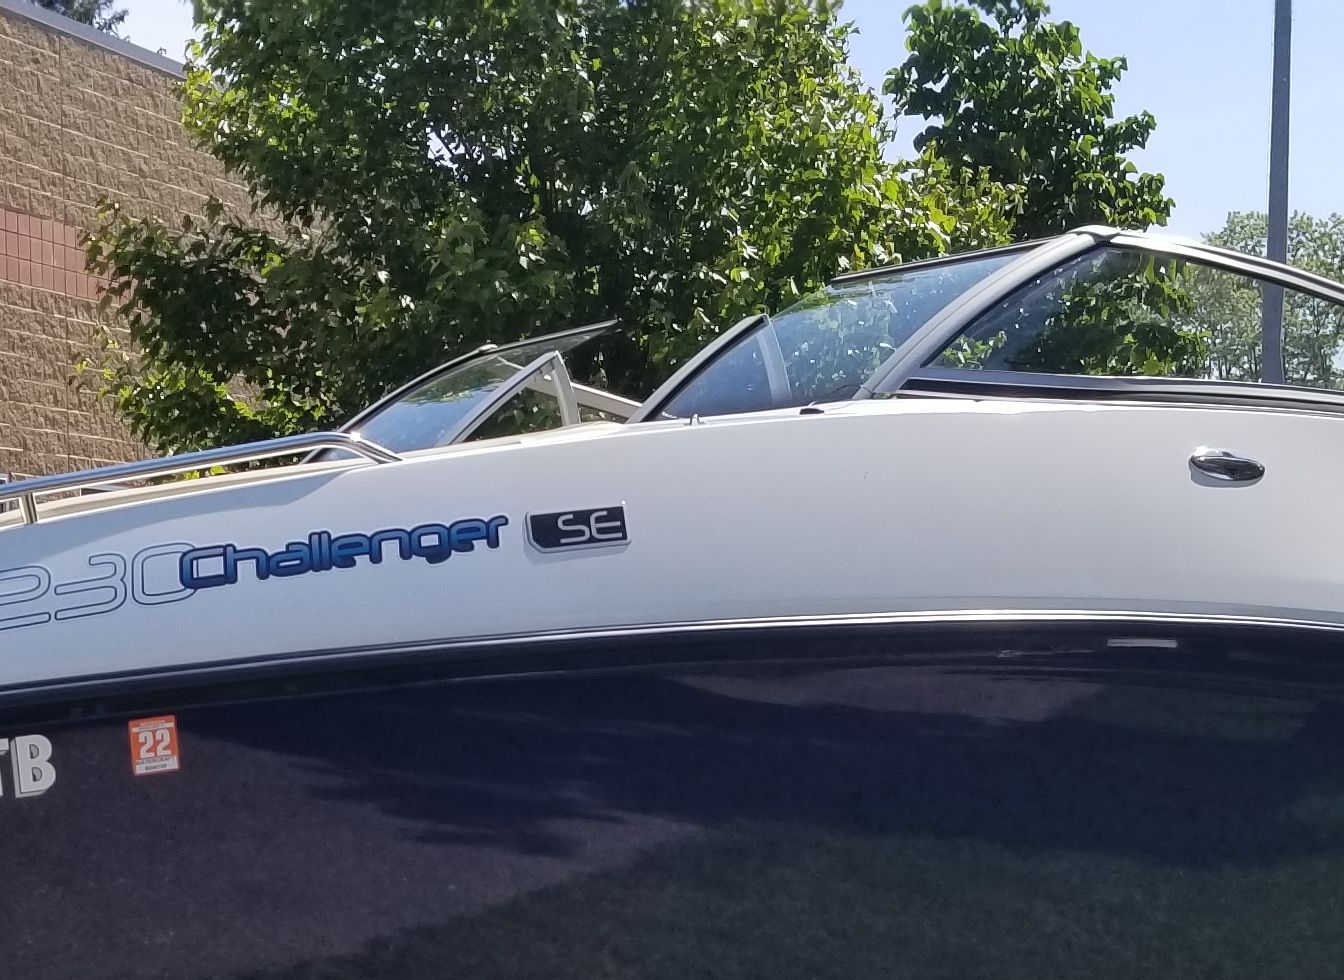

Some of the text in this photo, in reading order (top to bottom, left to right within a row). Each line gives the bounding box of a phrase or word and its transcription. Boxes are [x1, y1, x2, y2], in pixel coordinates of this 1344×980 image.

[178, 514, 509, 590] Challenger
[557, 510, 623, 544] SE
[138, 728, 172, 759] 22
